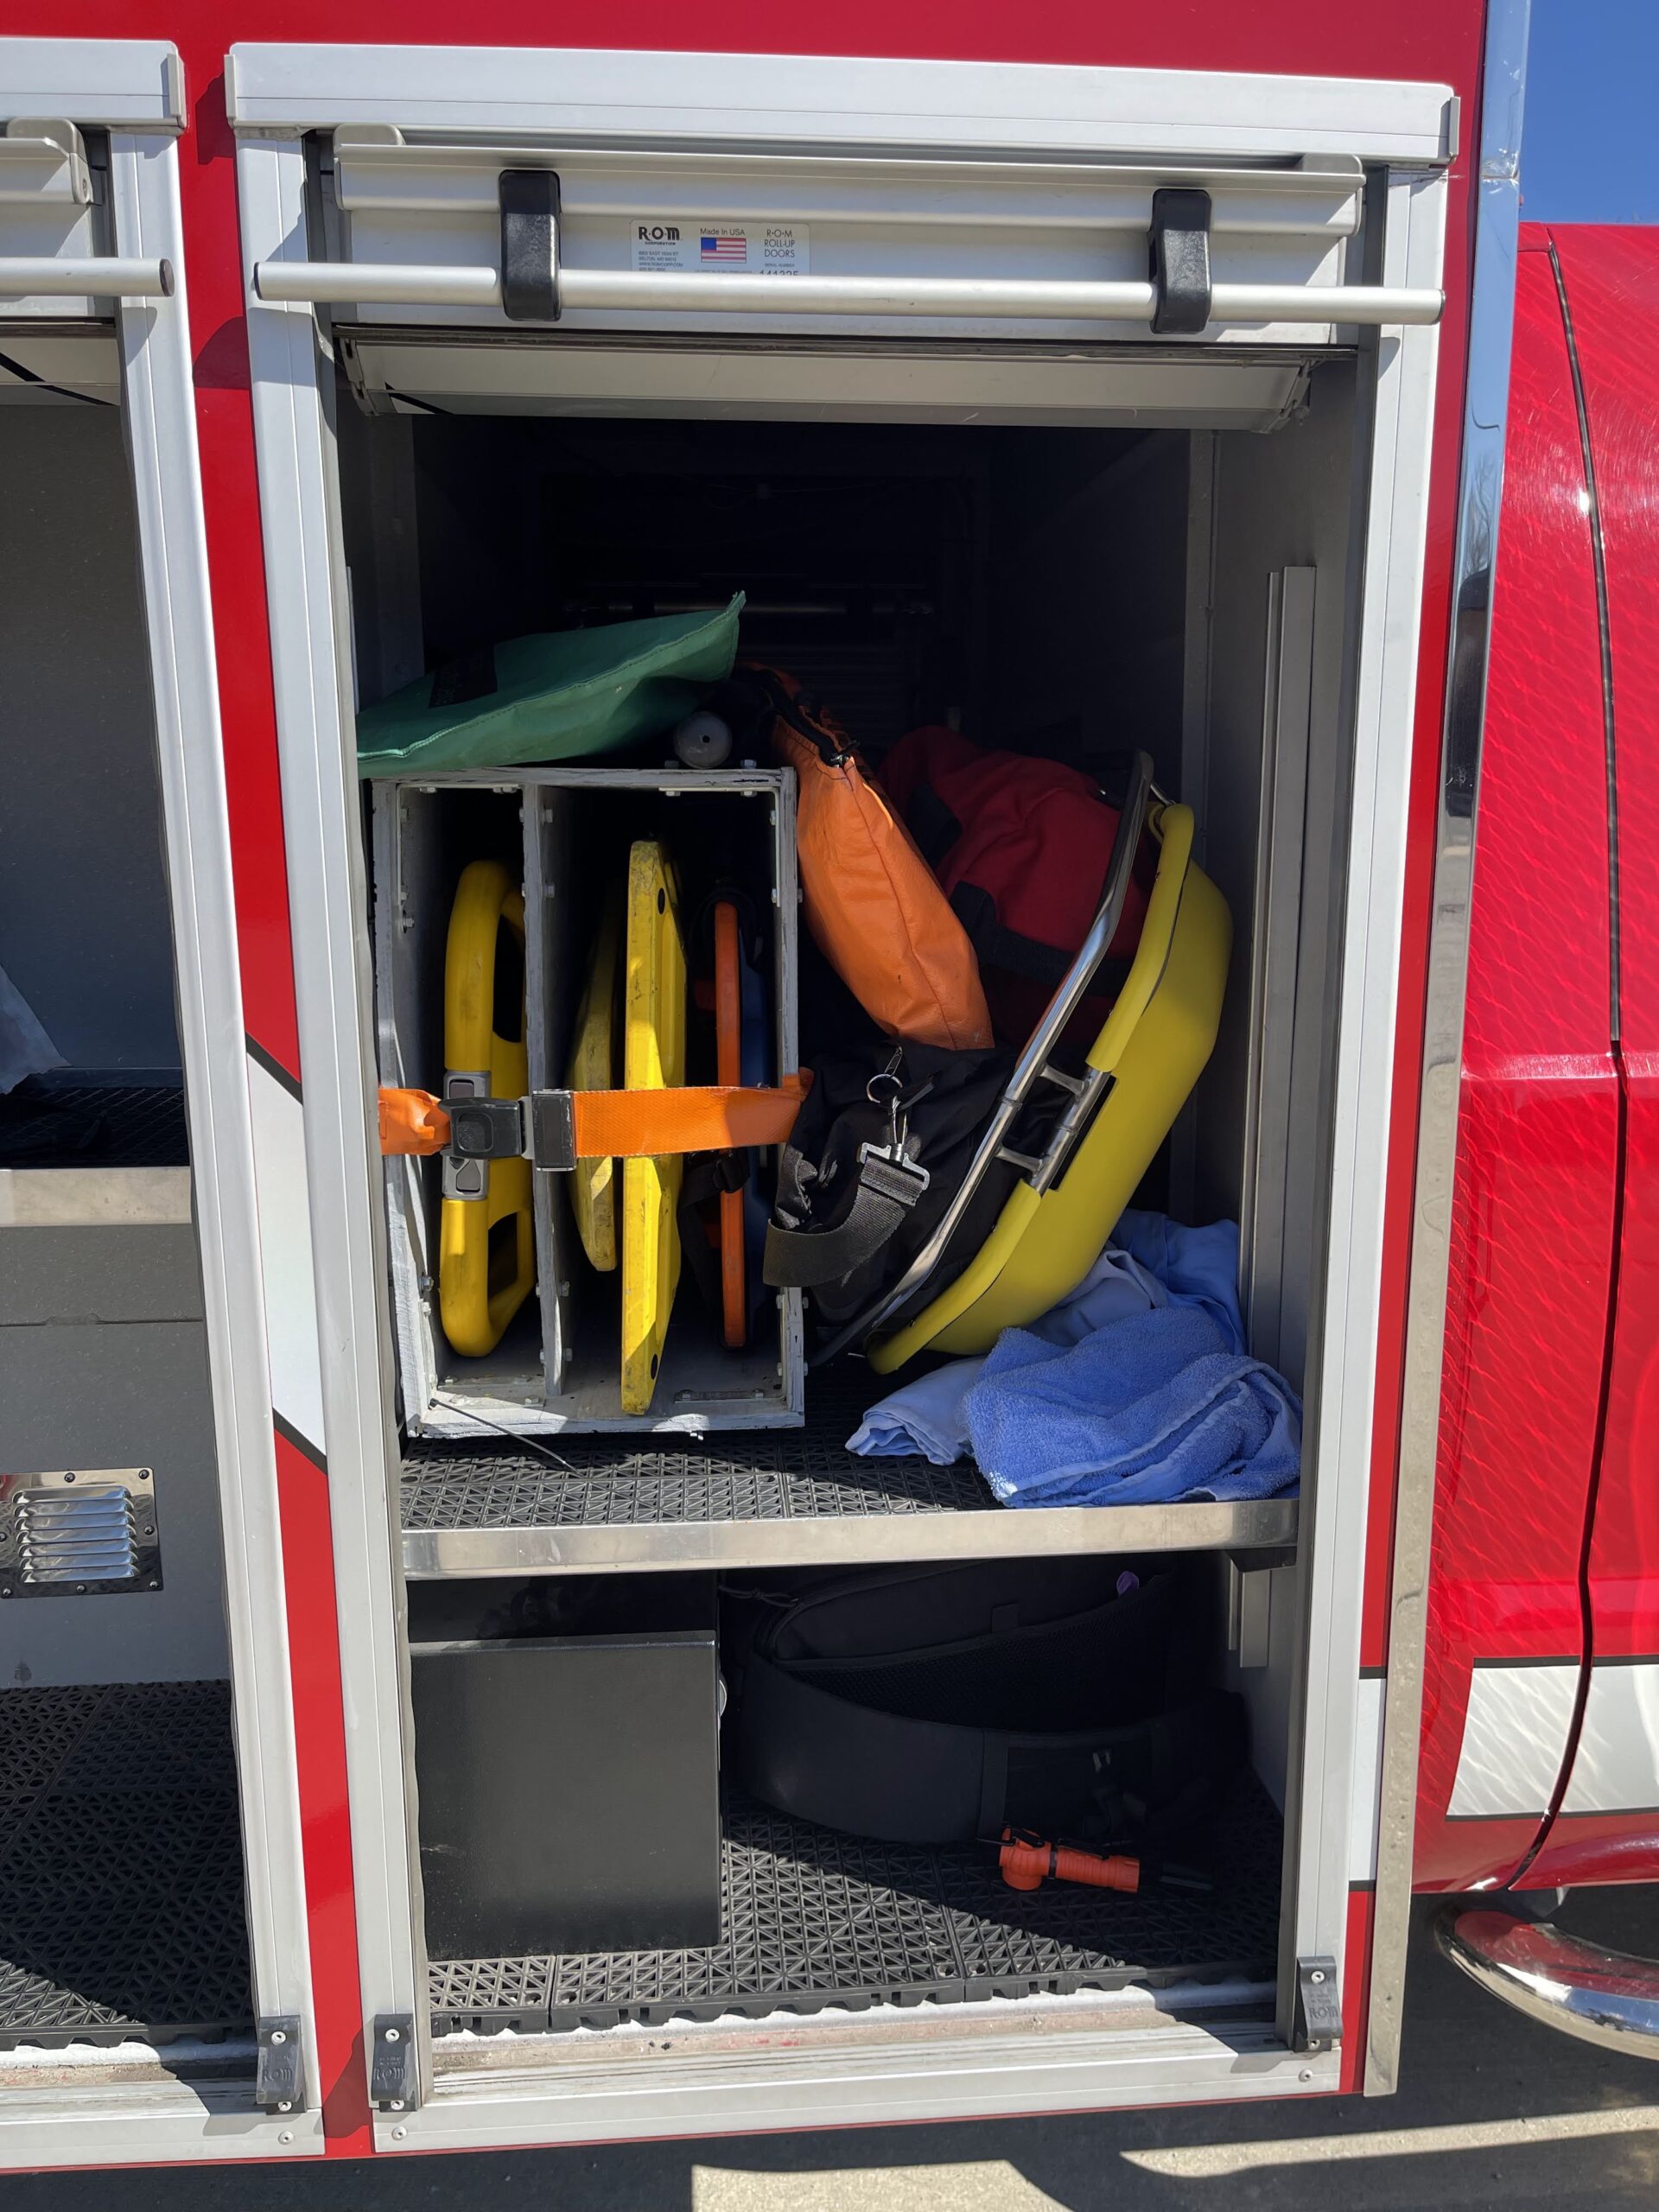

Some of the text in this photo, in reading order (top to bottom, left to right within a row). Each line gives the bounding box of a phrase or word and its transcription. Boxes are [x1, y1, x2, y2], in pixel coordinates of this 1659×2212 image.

[700, 227, 719, 236] Made
[764, 238, 795, 248] ROLL-UP
[764, 249, 795, 258] DOORS
